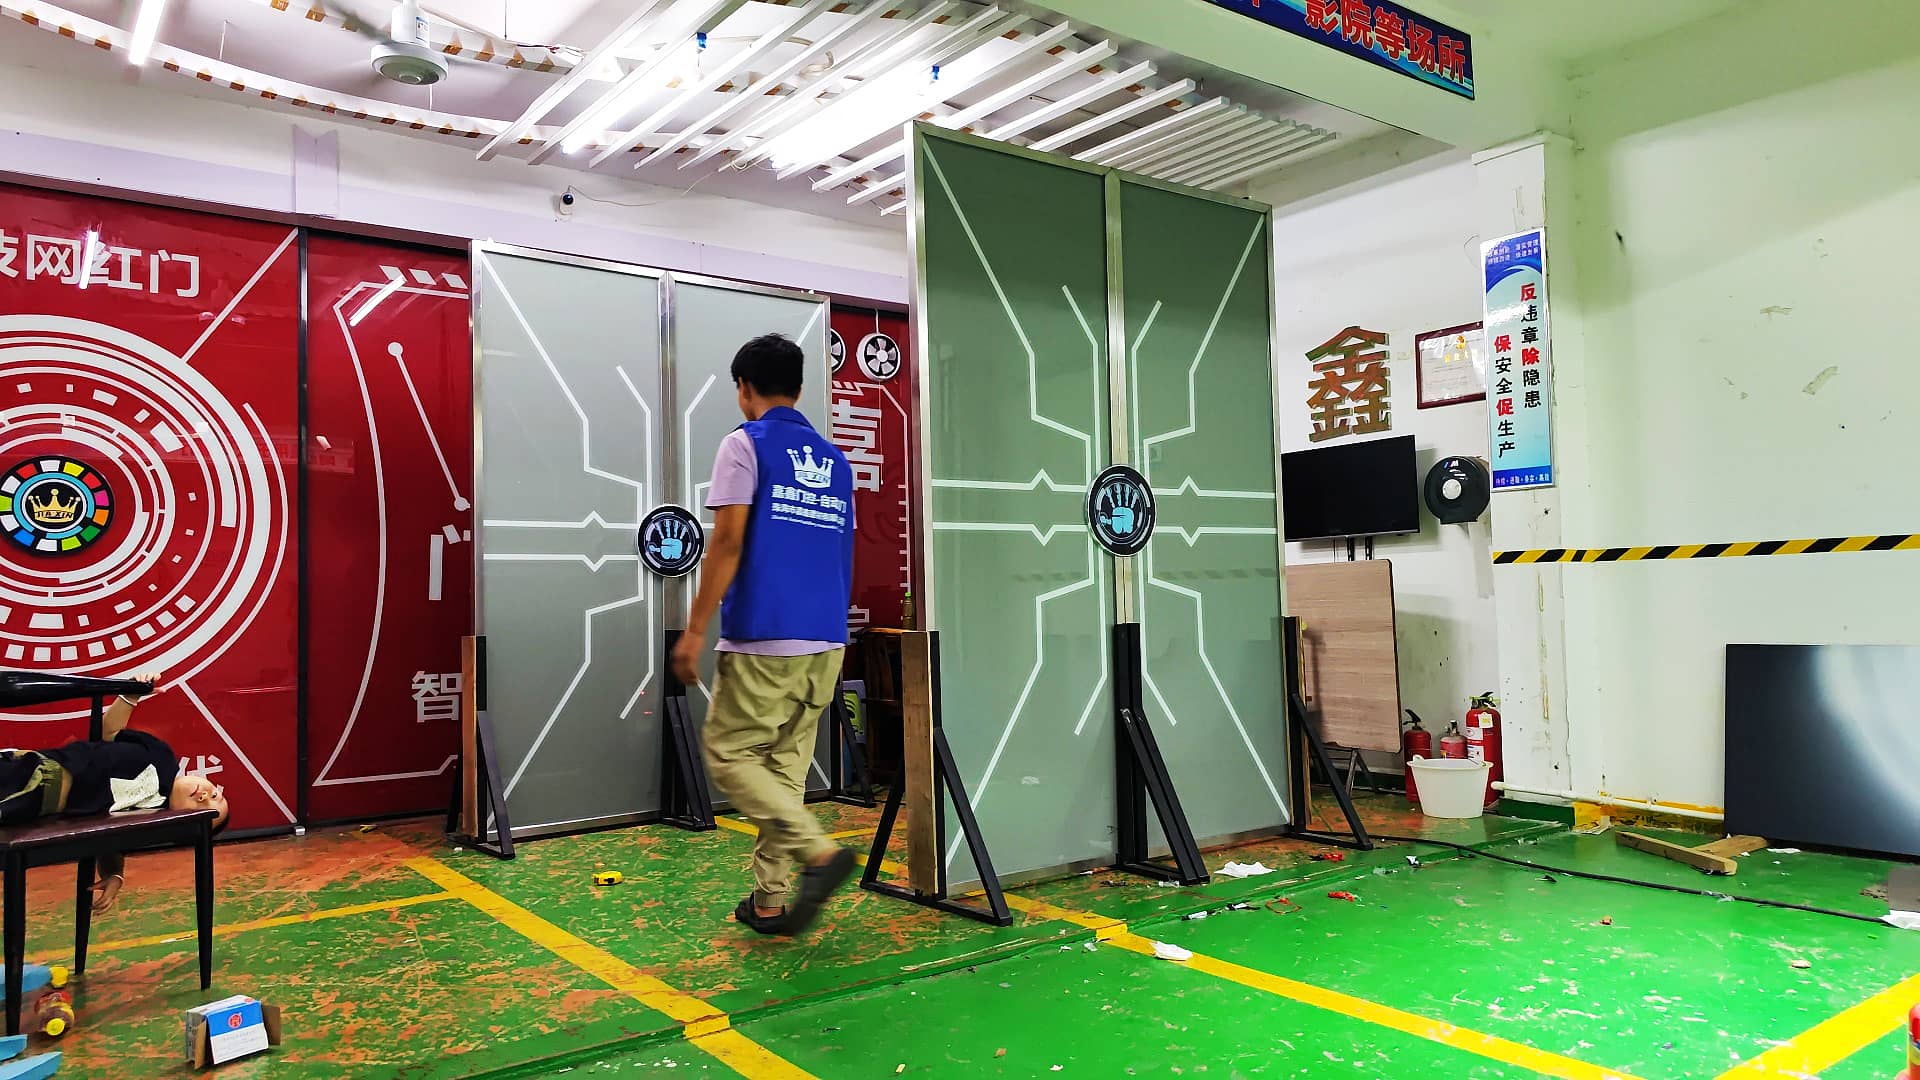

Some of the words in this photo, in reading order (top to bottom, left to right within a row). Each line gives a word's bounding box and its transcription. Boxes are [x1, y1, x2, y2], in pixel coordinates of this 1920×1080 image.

[1305, 325, 1392, 443] 鑫
[1493, 334, 1516, 459] 保安全促生产
[1520, 282, 1542, 409] 反违章除隐患
